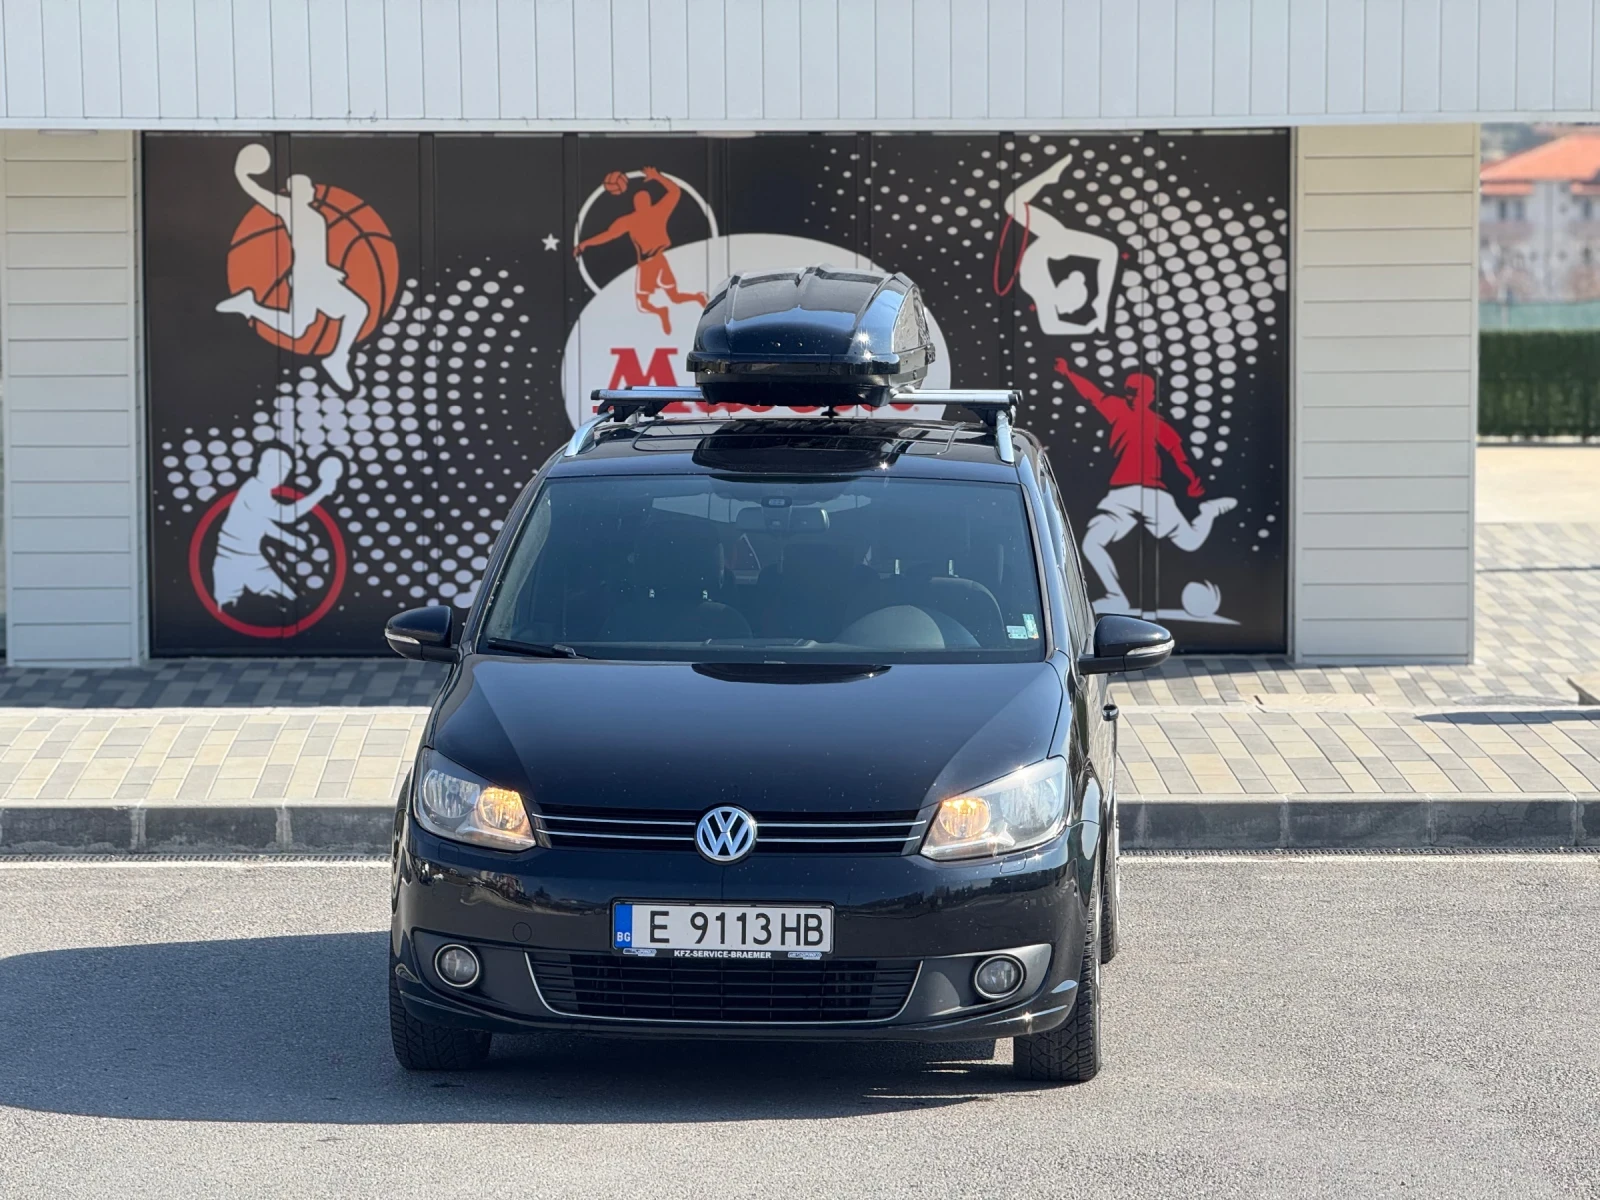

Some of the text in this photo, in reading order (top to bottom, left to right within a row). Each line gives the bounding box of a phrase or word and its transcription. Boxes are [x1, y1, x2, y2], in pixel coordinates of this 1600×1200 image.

[650, 910, 824, 947] E 9113 HB
[616, 932, 631, 943] BG
[674, 949, 772, 959] KFZ-SERVICE-BRAEMER
